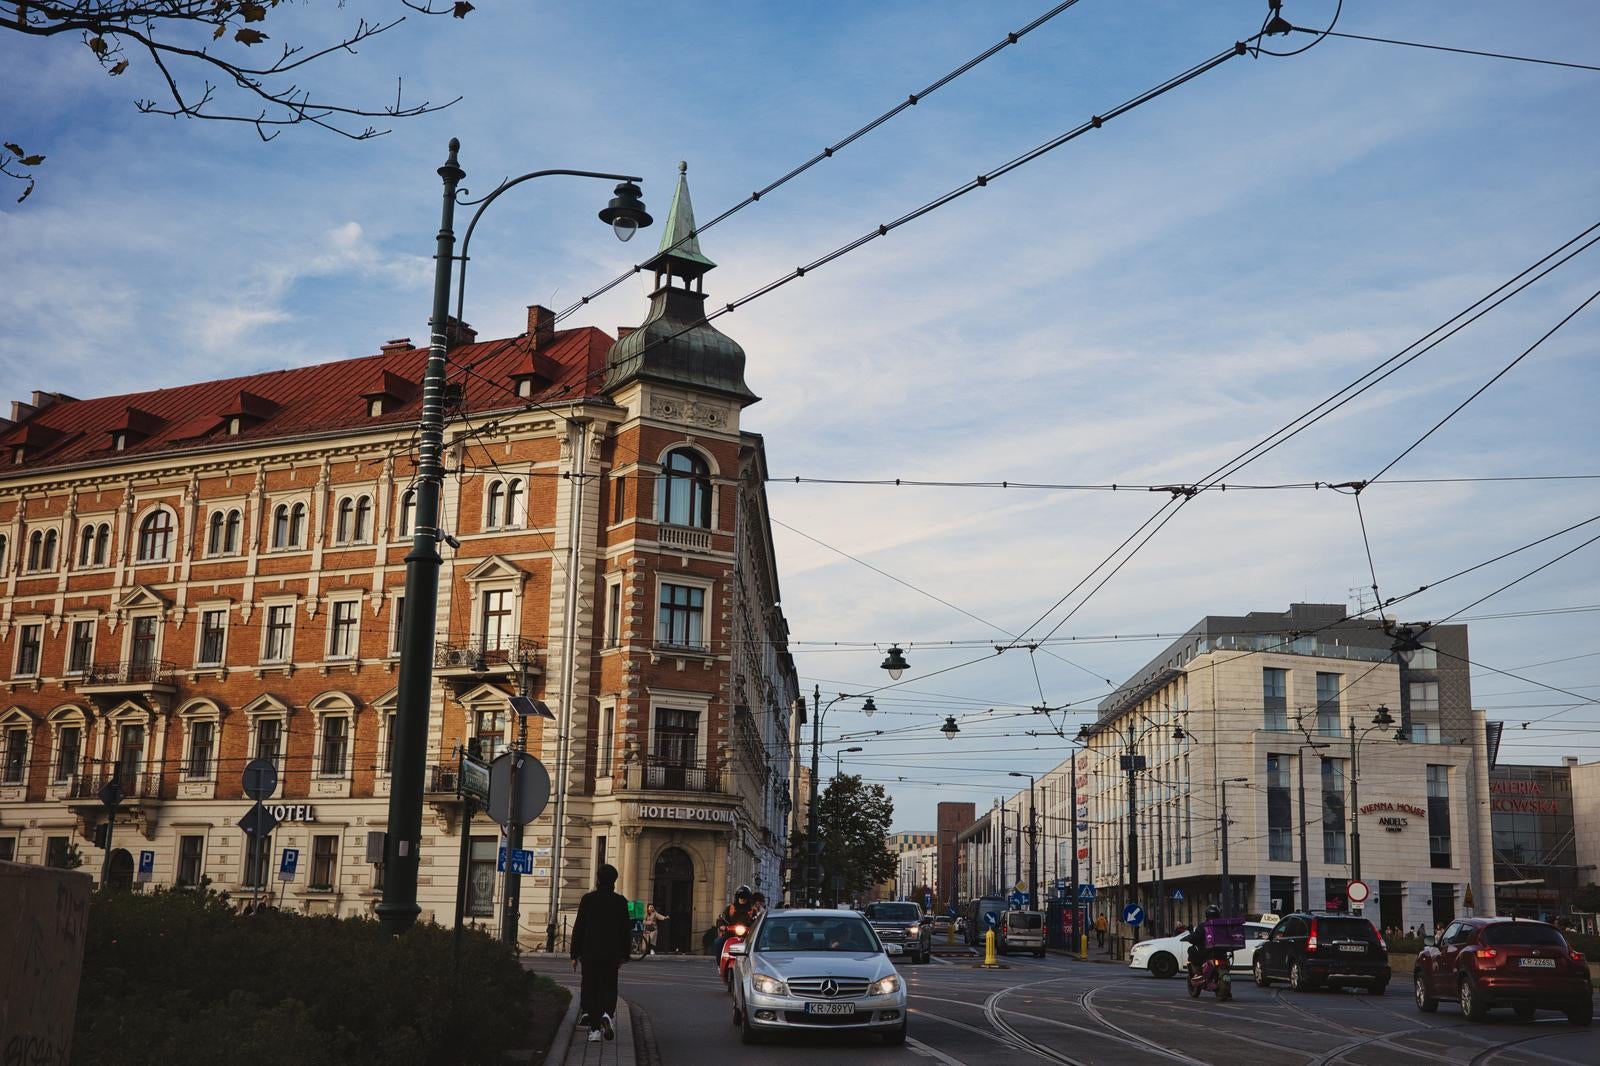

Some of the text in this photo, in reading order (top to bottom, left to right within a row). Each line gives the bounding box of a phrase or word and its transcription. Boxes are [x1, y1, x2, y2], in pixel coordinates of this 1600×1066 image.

[1489, 780, 1542, 795] ALERIA
[639, 806, 735, 822] HOTEL POLONIA
[1360, 802, 1426, 818] VIENNA HOUSE
[142, 852, 152, 867] P
[284, 851, 295, 866] P
[1264, 914, 1279, 922] Uber
[811, 1003, 853, 1013] KR 789YV
